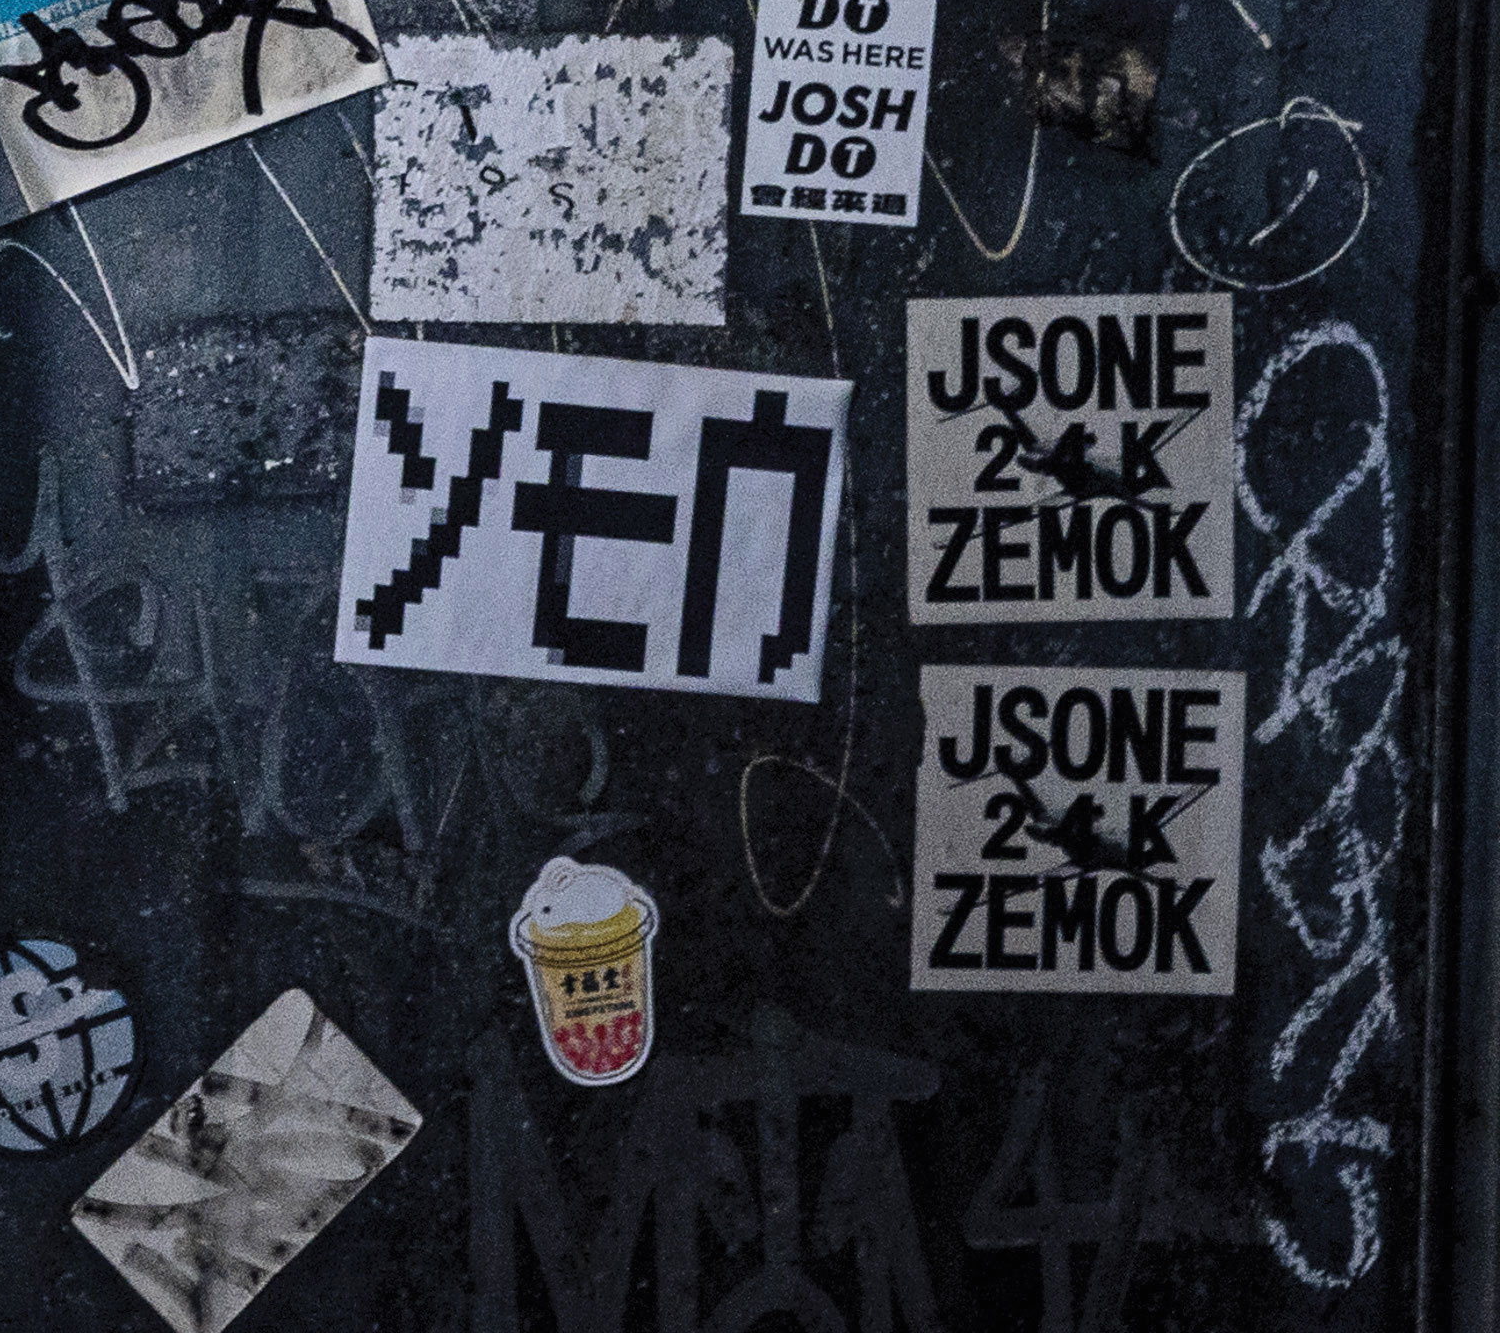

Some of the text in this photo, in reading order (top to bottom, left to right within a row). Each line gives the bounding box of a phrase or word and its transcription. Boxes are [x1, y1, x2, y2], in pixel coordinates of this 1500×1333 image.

[764, 36, 926, 70] WAS HERE
[758, 79, 918, 132] JOSH
[927, 312, 1212, 413] JSONE
[925, 501, 1212, 604] ZEMOK
[938, 684, 1221, 785] JSONE
[928, 872, 1216, 975] ZEMOK
